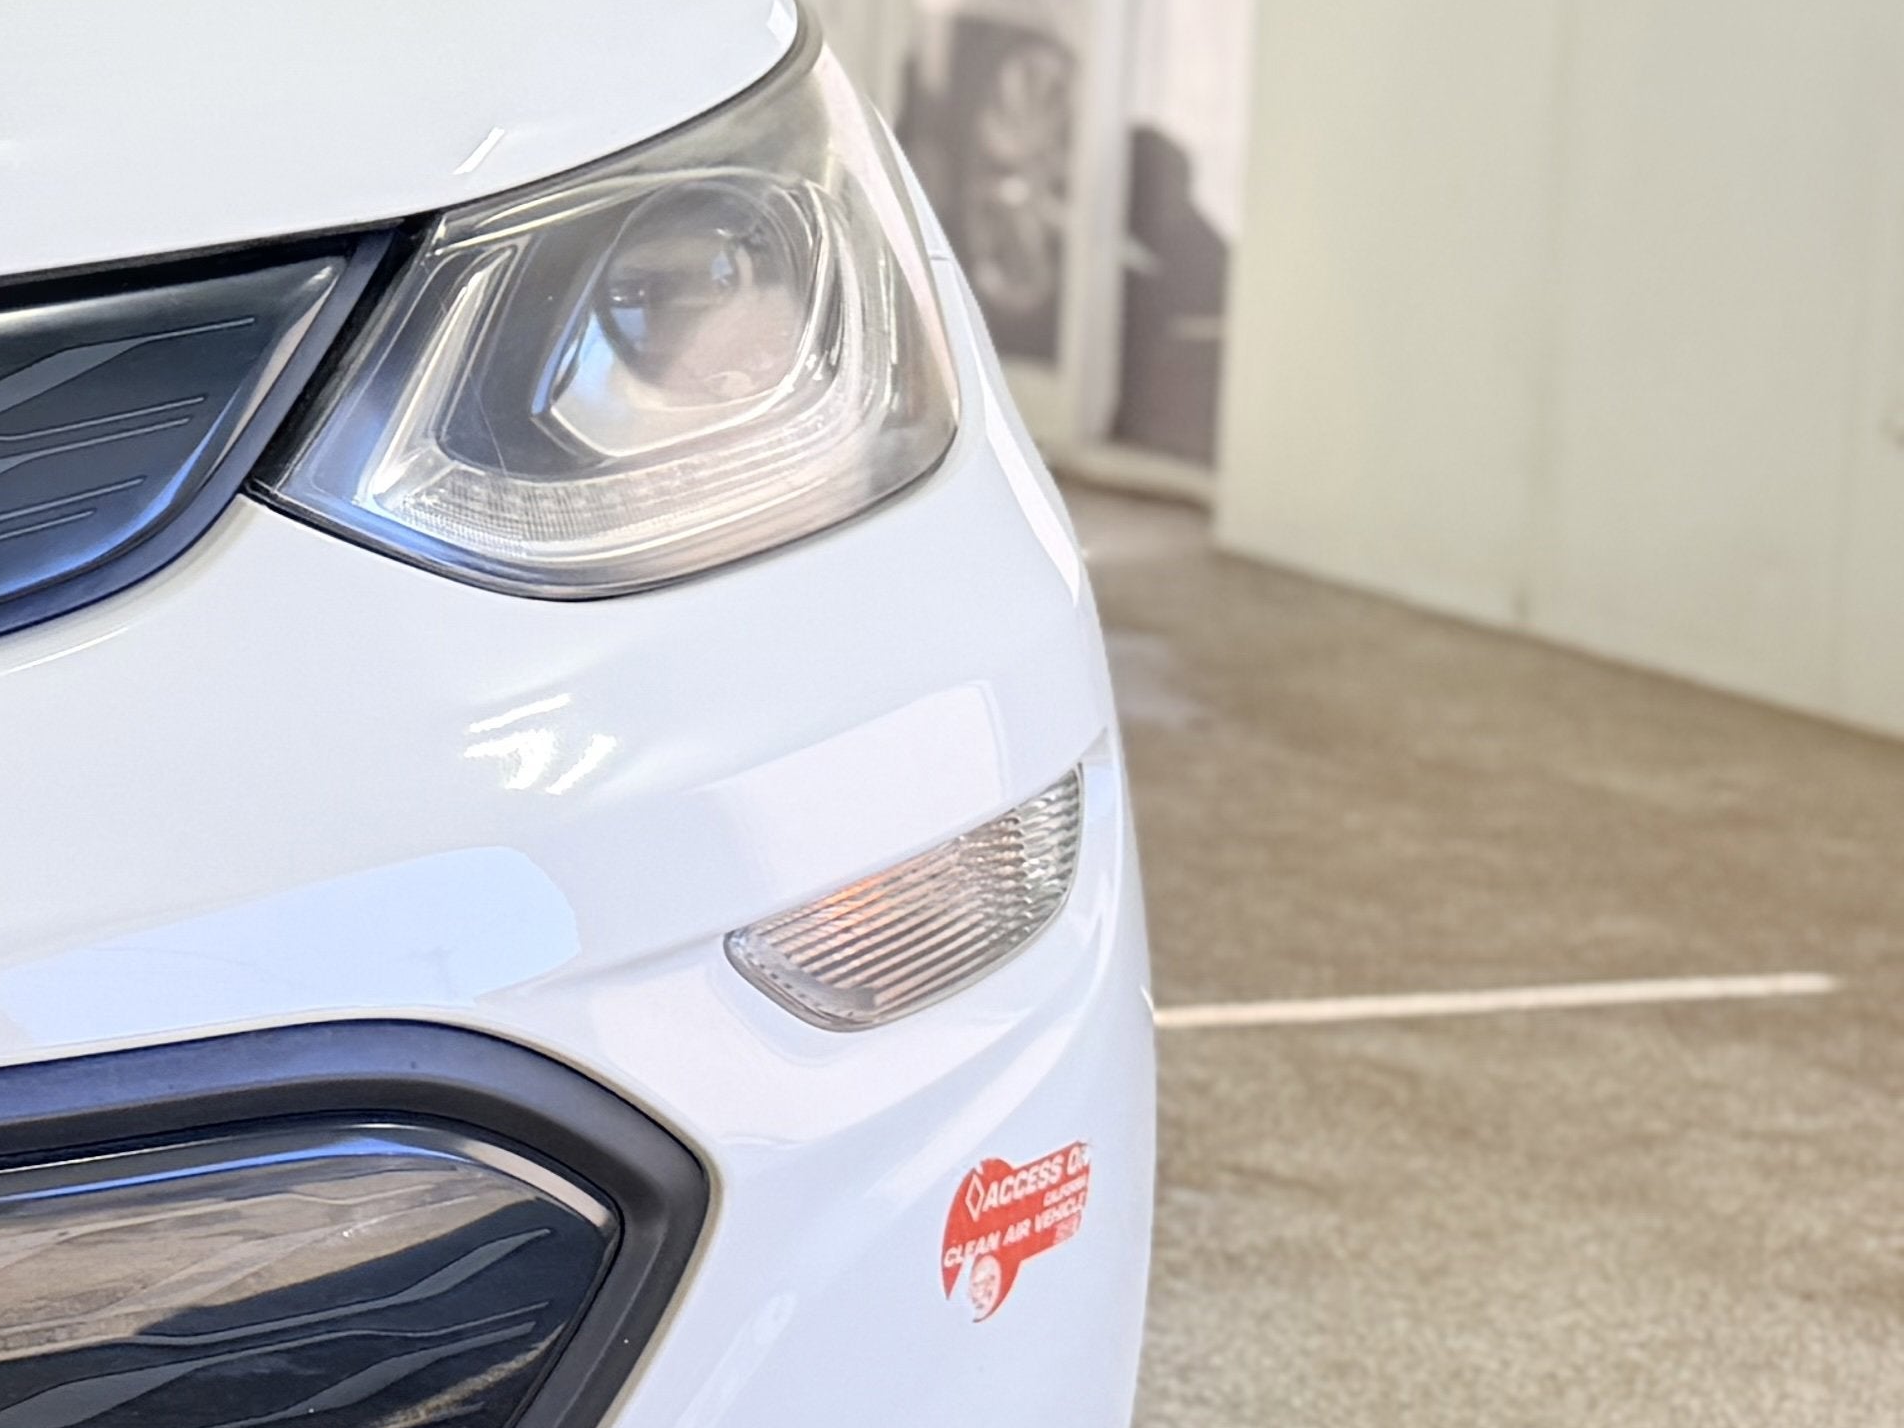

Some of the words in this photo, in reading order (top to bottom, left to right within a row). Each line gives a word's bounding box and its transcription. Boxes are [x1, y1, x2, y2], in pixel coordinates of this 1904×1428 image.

[982, 1155, 1064, 1212] ACCESS
[944, 1230, 1001, 1268] CLEAN
[1002, 1218, 1032, 1247] AIR
